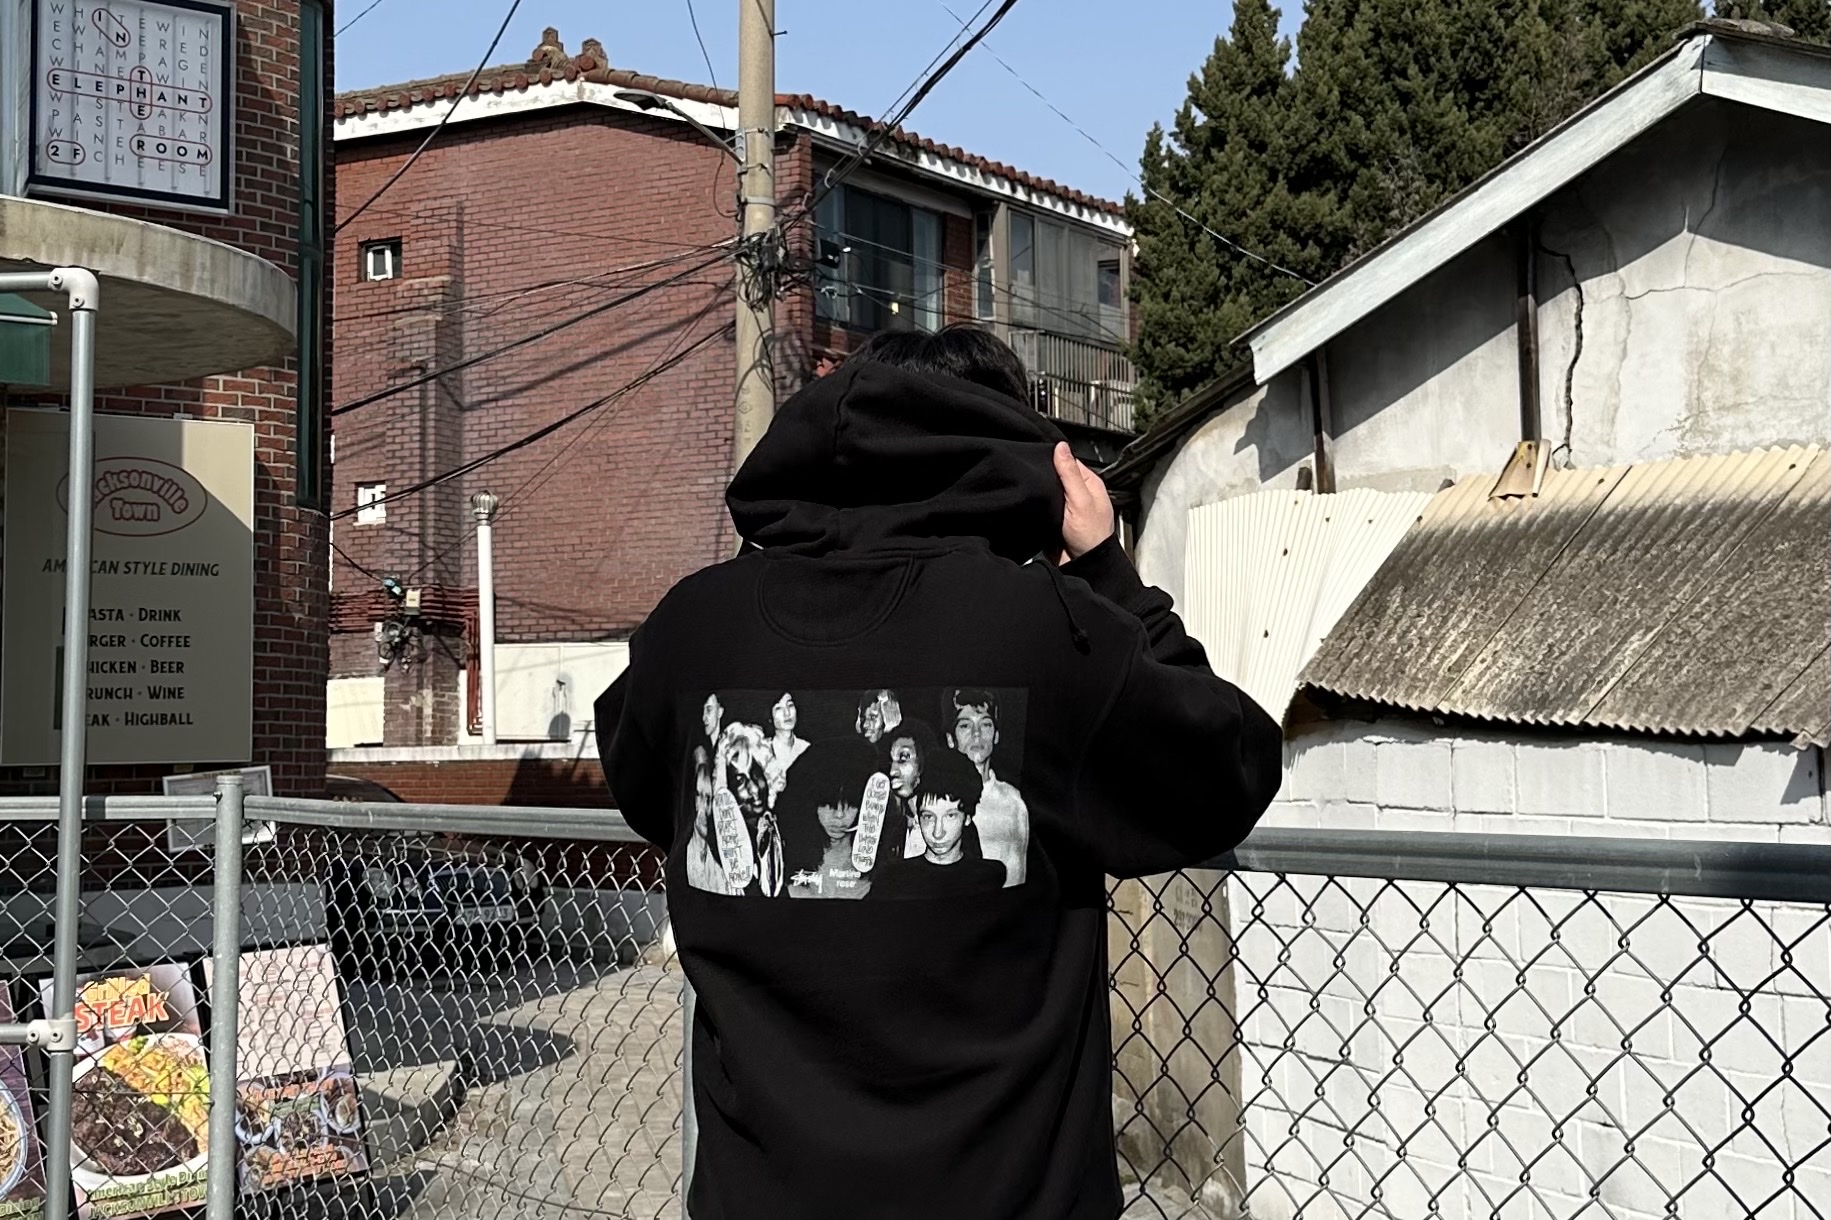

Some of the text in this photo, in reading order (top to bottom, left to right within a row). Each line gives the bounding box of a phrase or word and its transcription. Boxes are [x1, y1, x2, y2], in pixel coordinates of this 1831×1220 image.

[52, 74, 208, 108] ELEPHANT
[94, 468, 189, 514] cksonville
[110, 497, 160, 522] Town
[123, 560, 168, 576] STYLE
[171, 562, 220, 577] DINING
[88, 607, 182, 622] ASTA DRINK
[89, 633, 191, 648] RGER COFFEE
[150, 659, 185, 674] BEER
[87, 685, 185, 700] RUNCH WINE
[124, 711, 194, 726] HIGHBALL
[74, 992, 170, 1031] STEAK
